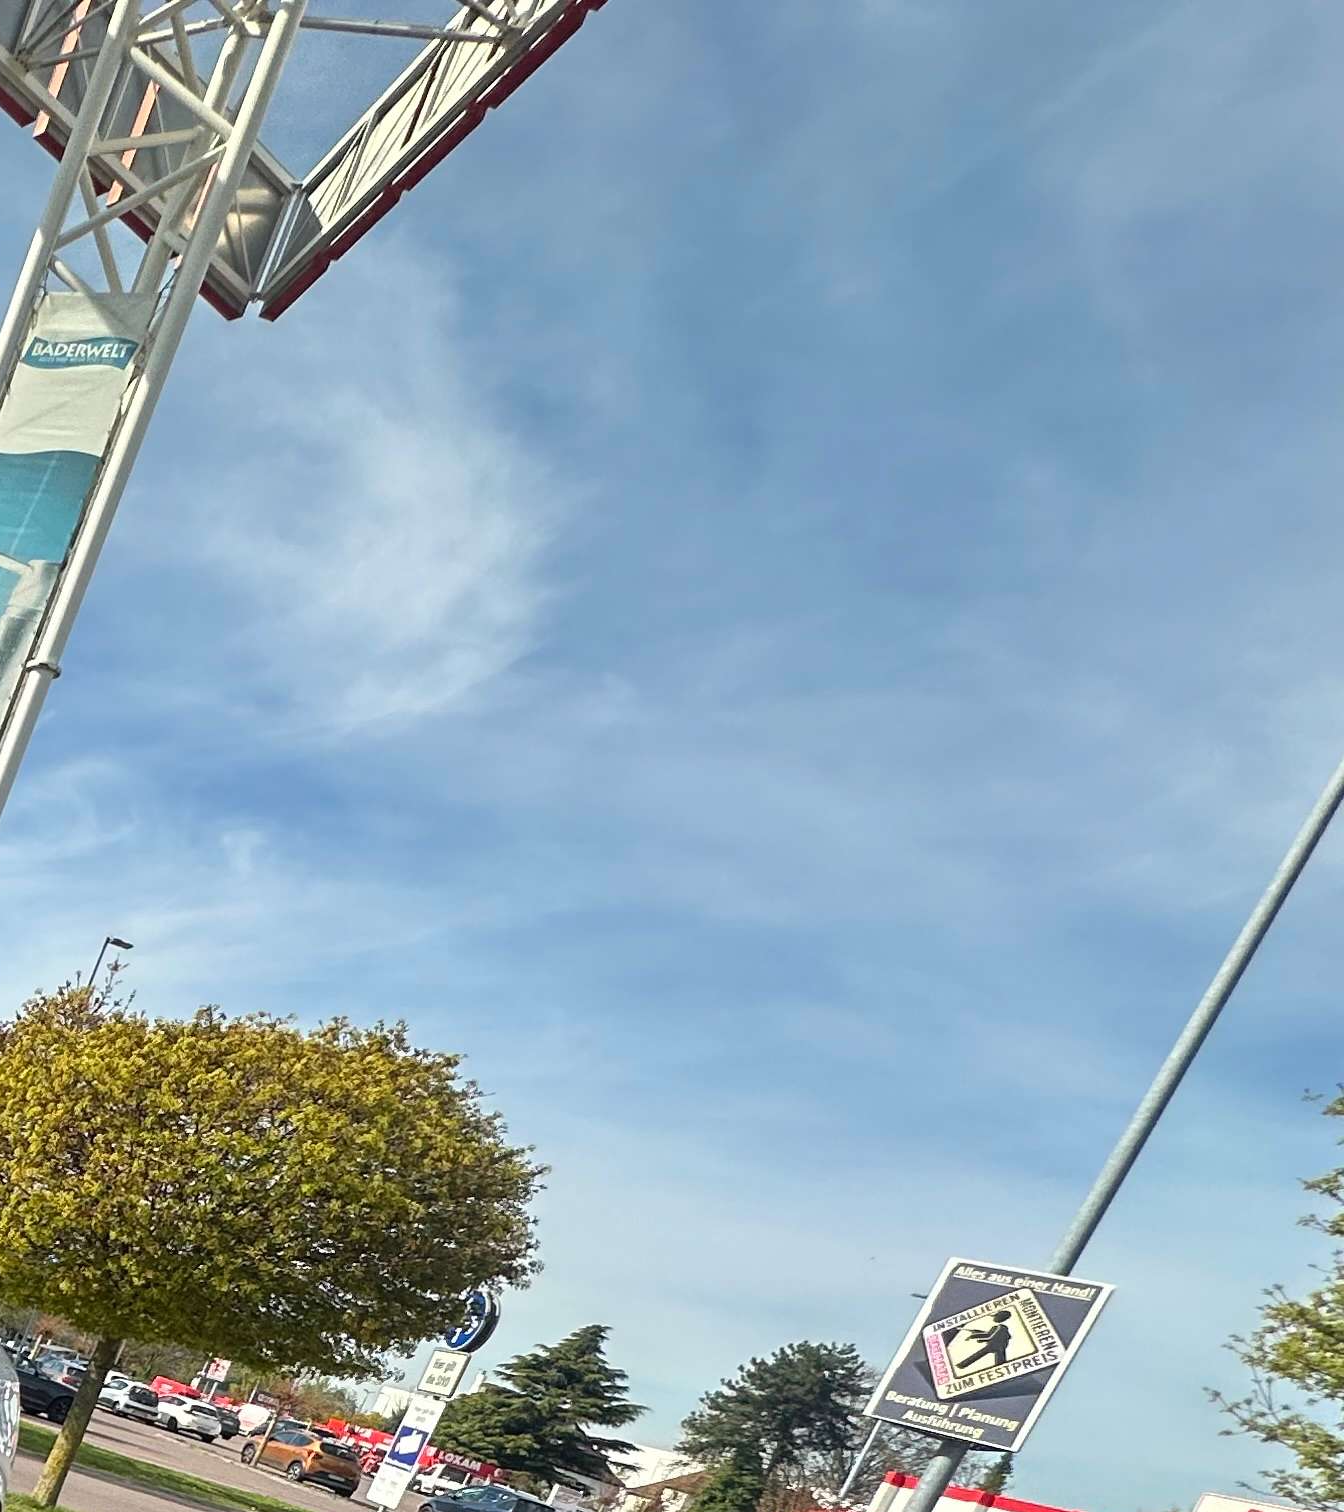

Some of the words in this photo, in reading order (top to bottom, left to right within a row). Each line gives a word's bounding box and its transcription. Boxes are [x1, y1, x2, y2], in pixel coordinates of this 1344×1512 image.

[956, 1265, 986, 1280] Alles
[987, 1273, 1012, 1284] aus
[1013, 1276, 1050, 1292] einer
[1051, 1282, 1097, 1299] Hand!
[932, 1293, 1021, 1332] INSTALLIEREN
[1020, 1297, 1059, 1351] MONTIEREN
[945, 1378, 975, 1395] ZUM
[977, 1350, 1058, 1384] FESTPREIS
[885, 1390, 949, 1416] Beratung
[957, 1407, 1020, 1432] Planung
[902, 1410, 985, 1440] Ausführung
[438, 1450, 481, 1472] LOXAM
